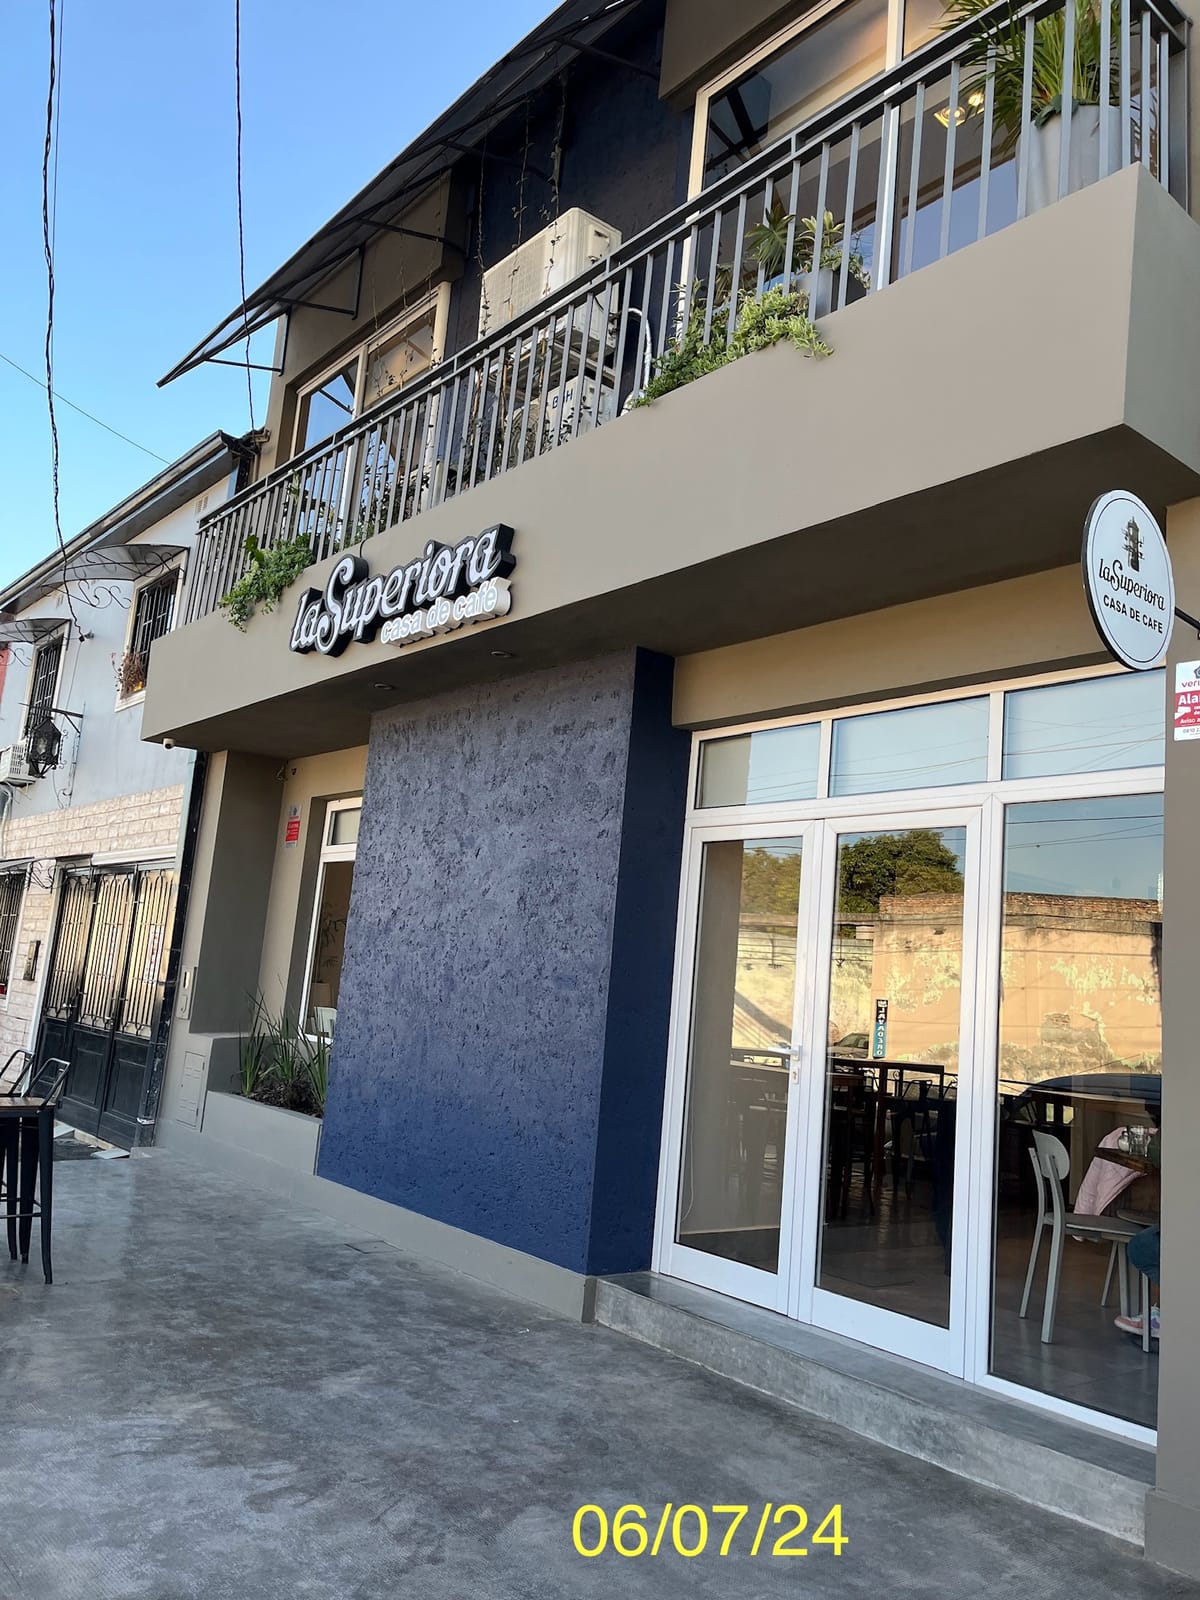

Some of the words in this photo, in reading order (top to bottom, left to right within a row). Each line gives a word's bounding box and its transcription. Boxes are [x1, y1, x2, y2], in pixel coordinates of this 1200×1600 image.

[552, 388, 574, 409] BH
[381, 610, 423, 644] casa
[427, 597, 451, 629] de
[453, 577, 498, 621] café
[1103, 594, 1127, 616] CASA
[1130, 607, 1141, 622] DE
[1142, 614, 1163, 634] CAFE
[1178, 692, 1200, 706] Ala
